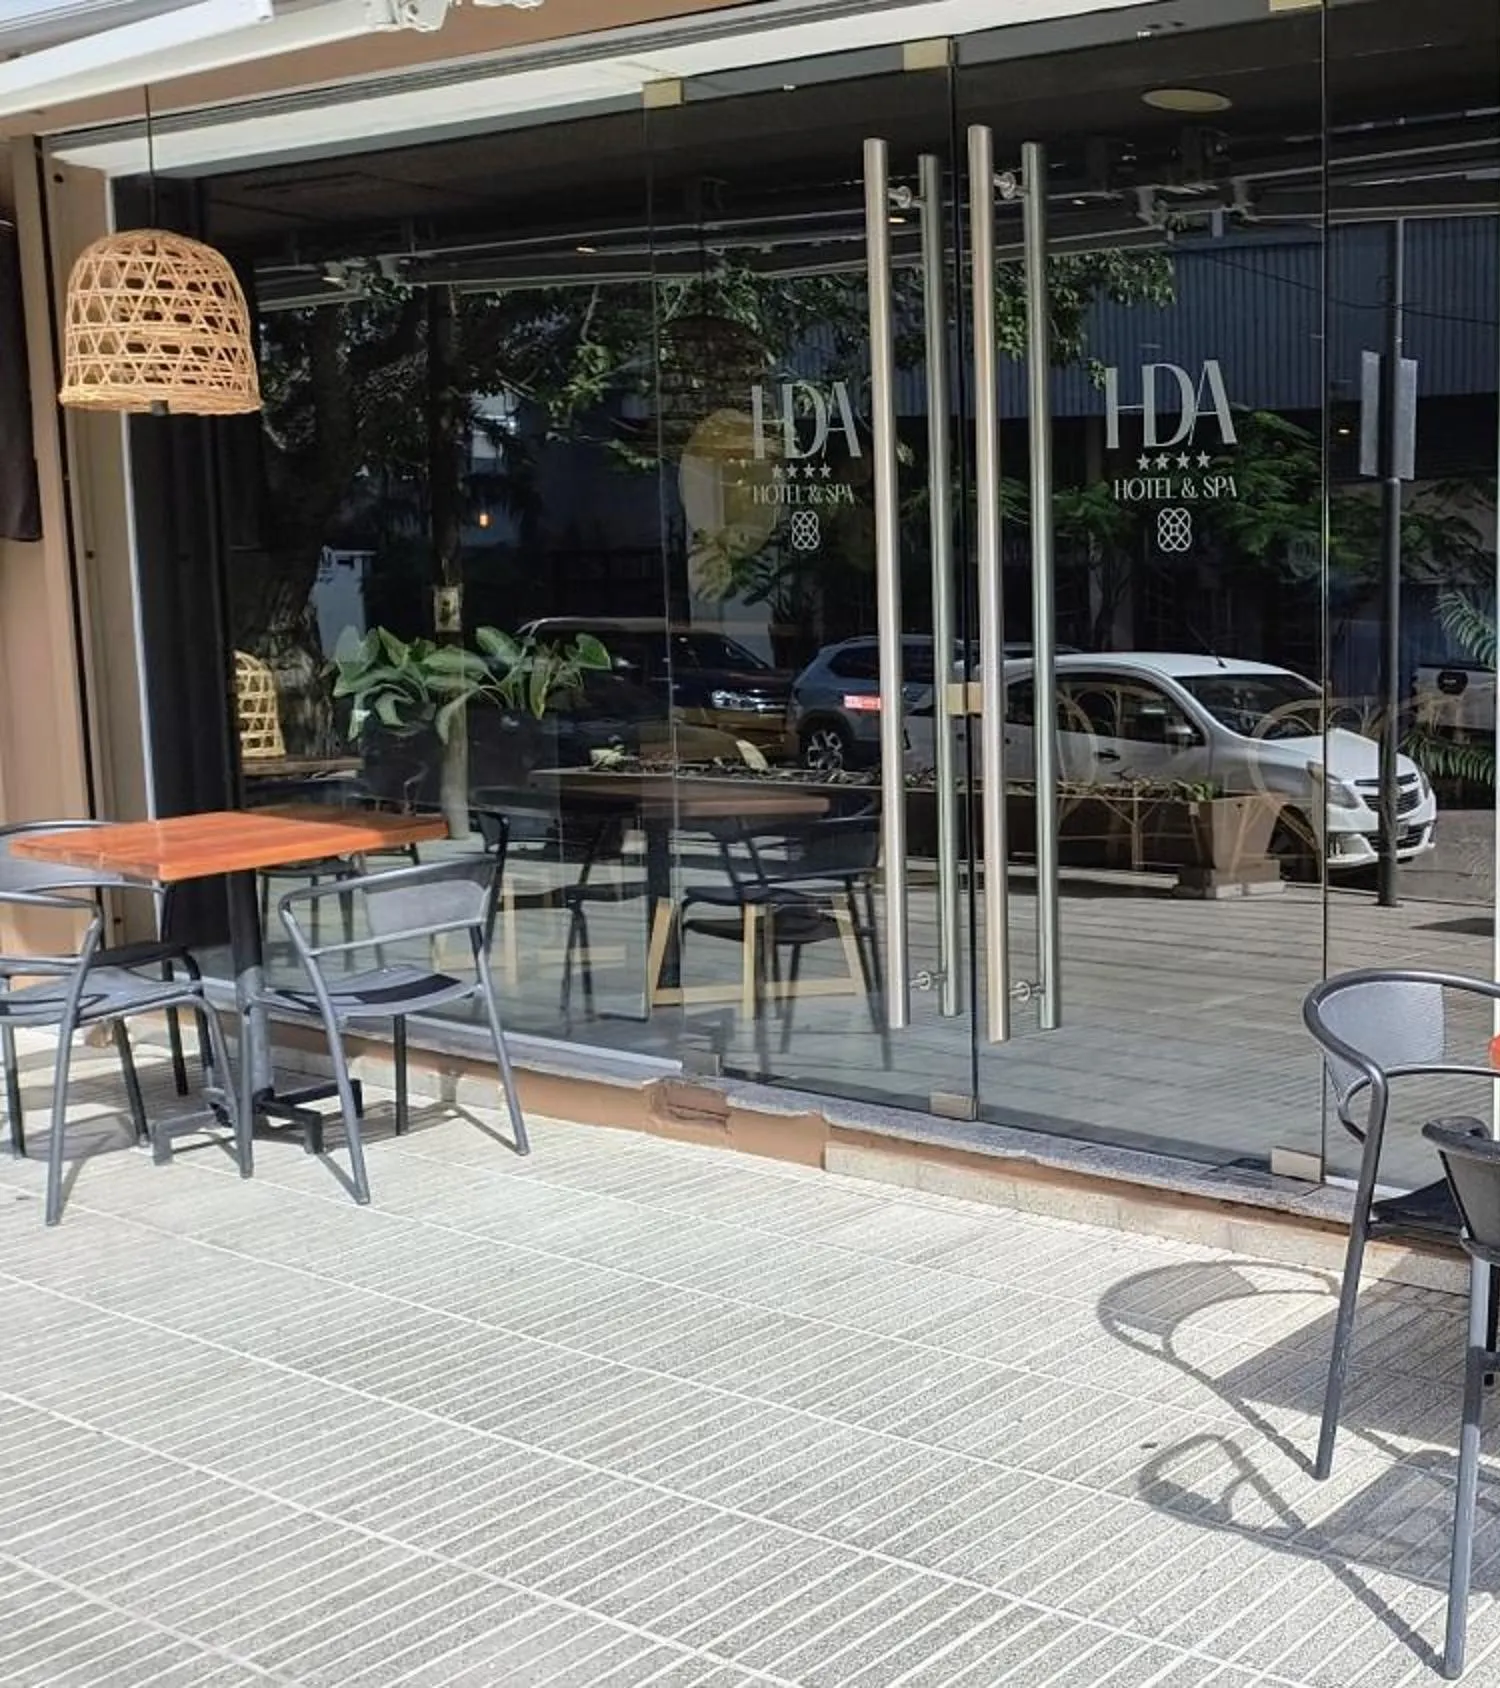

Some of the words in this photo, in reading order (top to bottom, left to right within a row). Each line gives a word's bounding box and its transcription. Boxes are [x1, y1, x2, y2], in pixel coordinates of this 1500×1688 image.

[752, 382, 862, 459] HDA
[1104, 360, 1238, 449] HDA
[753, 483, 801, 504] HOTEL
[807, 483, 823, 504] &
[825, 483, 855, 504] SPA
[1114, 478, 1177, 501] HOTEL
[1181, 477, 1199, 500] &
[1203, 476, 1237, 499] SPA
